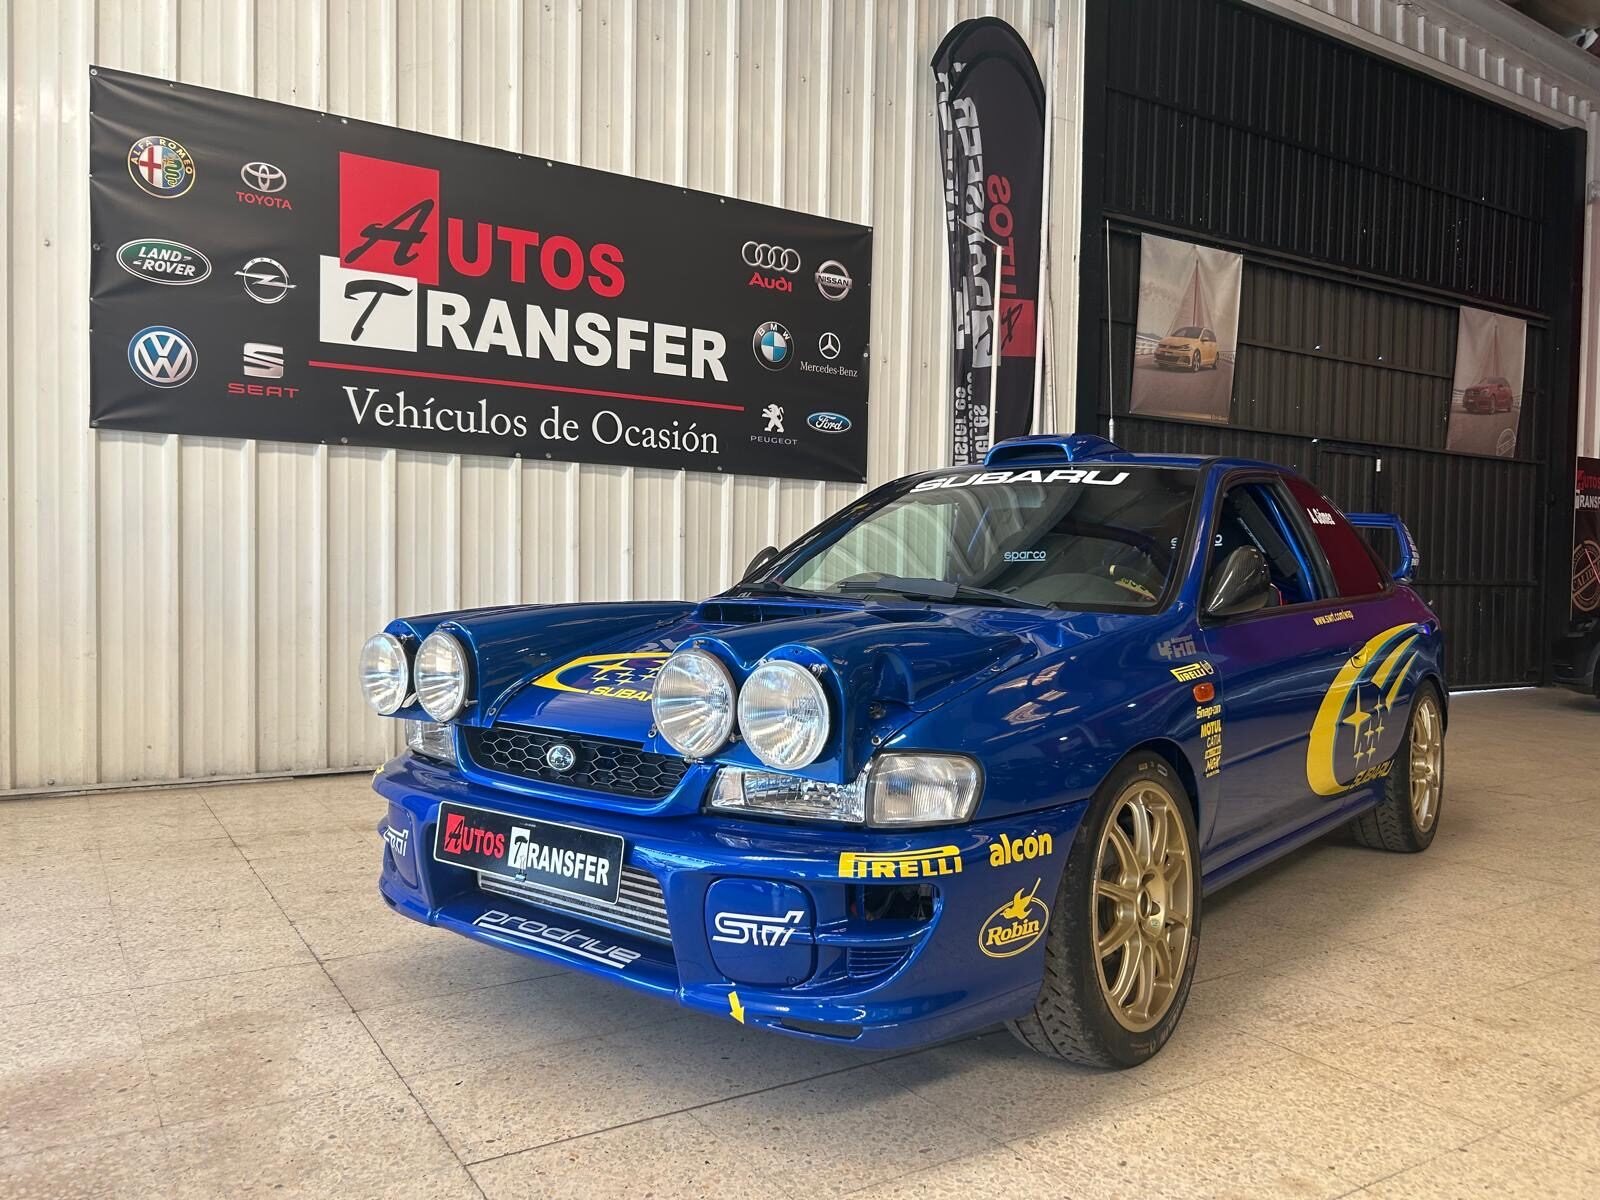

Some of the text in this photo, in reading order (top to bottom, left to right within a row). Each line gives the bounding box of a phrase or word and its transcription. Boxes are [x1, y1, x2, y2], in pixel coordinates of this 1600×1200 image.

[131, 138, 193, 175] ALFA ROMEO
[236, 191, 292, 210] TOYOTA
[343, 198, 626, 298] AUTOS
[748, 271, 793, 293] Audi
[818, 274, 850, 287] NISSAN
[343, 278, 729, 382] TRANSFER
[757, 322, 792, 341] BMW
[800, 360, 859, 379] Mercedes-Benz
[227, 382, 300, 399] SEAT
[342, 384, 720, 454] Vehículos de Ocasión
[814, 415, 846, 432] Ford
[749, 435, 799, 446] PEUGEOT
[909, 469, 1131, 493] SUBARU
[1003, 550, 1046, 561] sparco
[1169, 662, 1207, 683] PIRELLI
[1200, 719, 1222, 739] MOTUL
[444, 818, 610, 886] AUTOS TRANSFER
[838, 844, 963, 878] PIRELLI
[988, 832, 1053, 868] alcon
[472, 909, 642, 963] prodrive
[985, 919, 1041, 947] Robin
